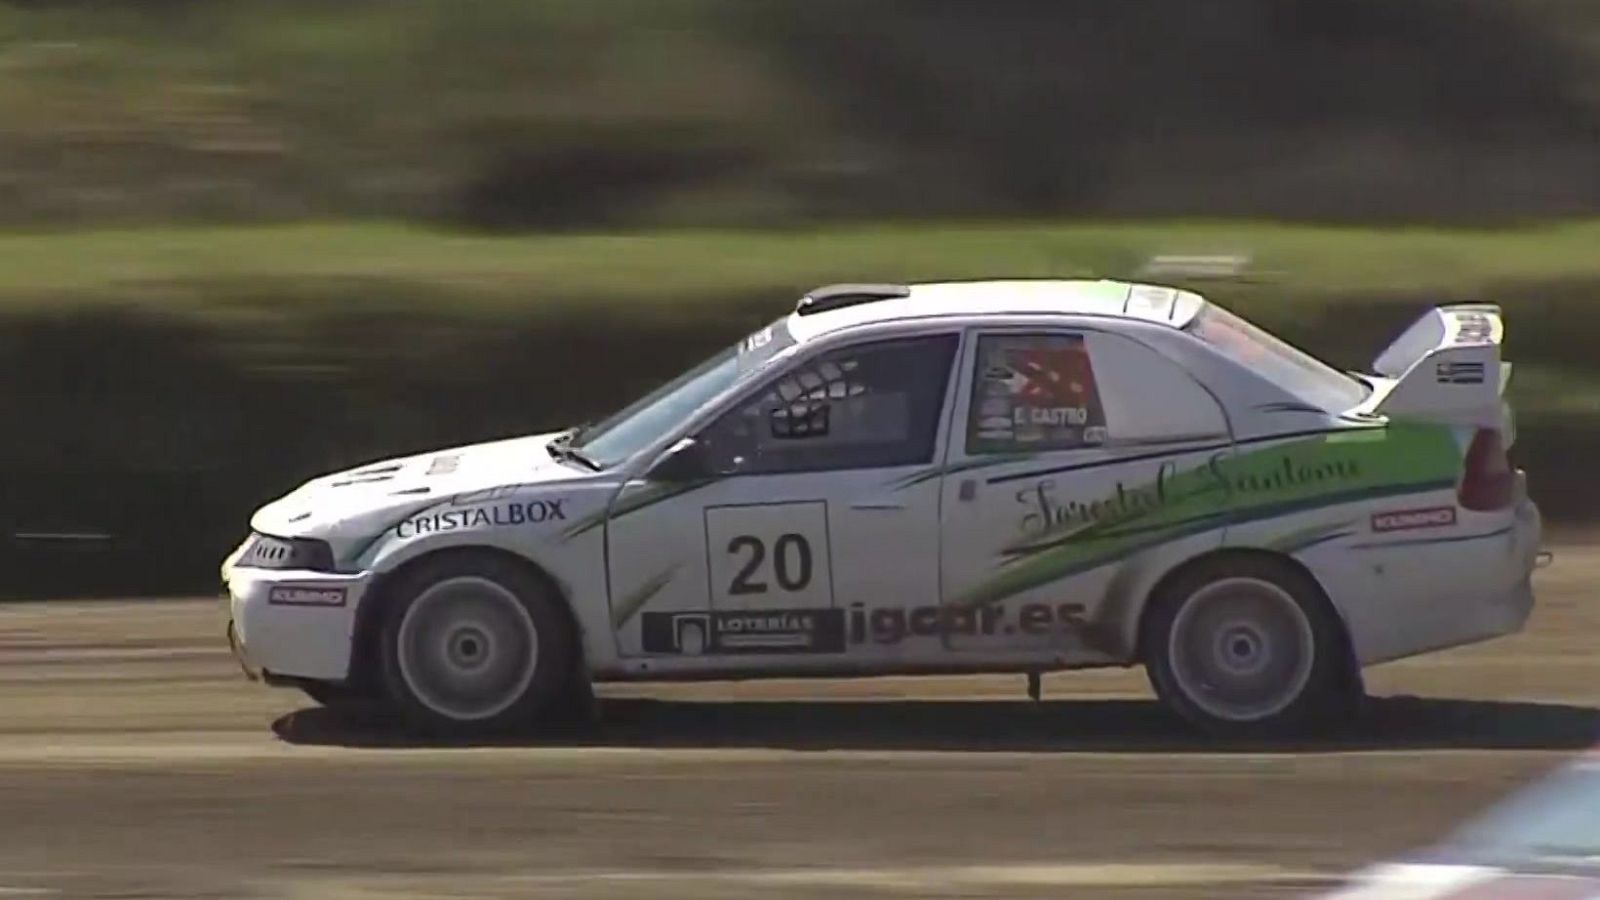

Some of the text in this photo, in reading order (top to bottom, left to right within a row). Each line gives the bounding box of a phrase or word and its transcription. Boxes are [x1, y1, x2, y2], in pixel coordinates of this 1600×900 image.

[1031, 407, 1087, 424] CASTRO
[397, 499, 566, 538] CRISTALBOX
[727, 533, 813, 595] 20
[850, 602, 1086, 645] igcar.es
